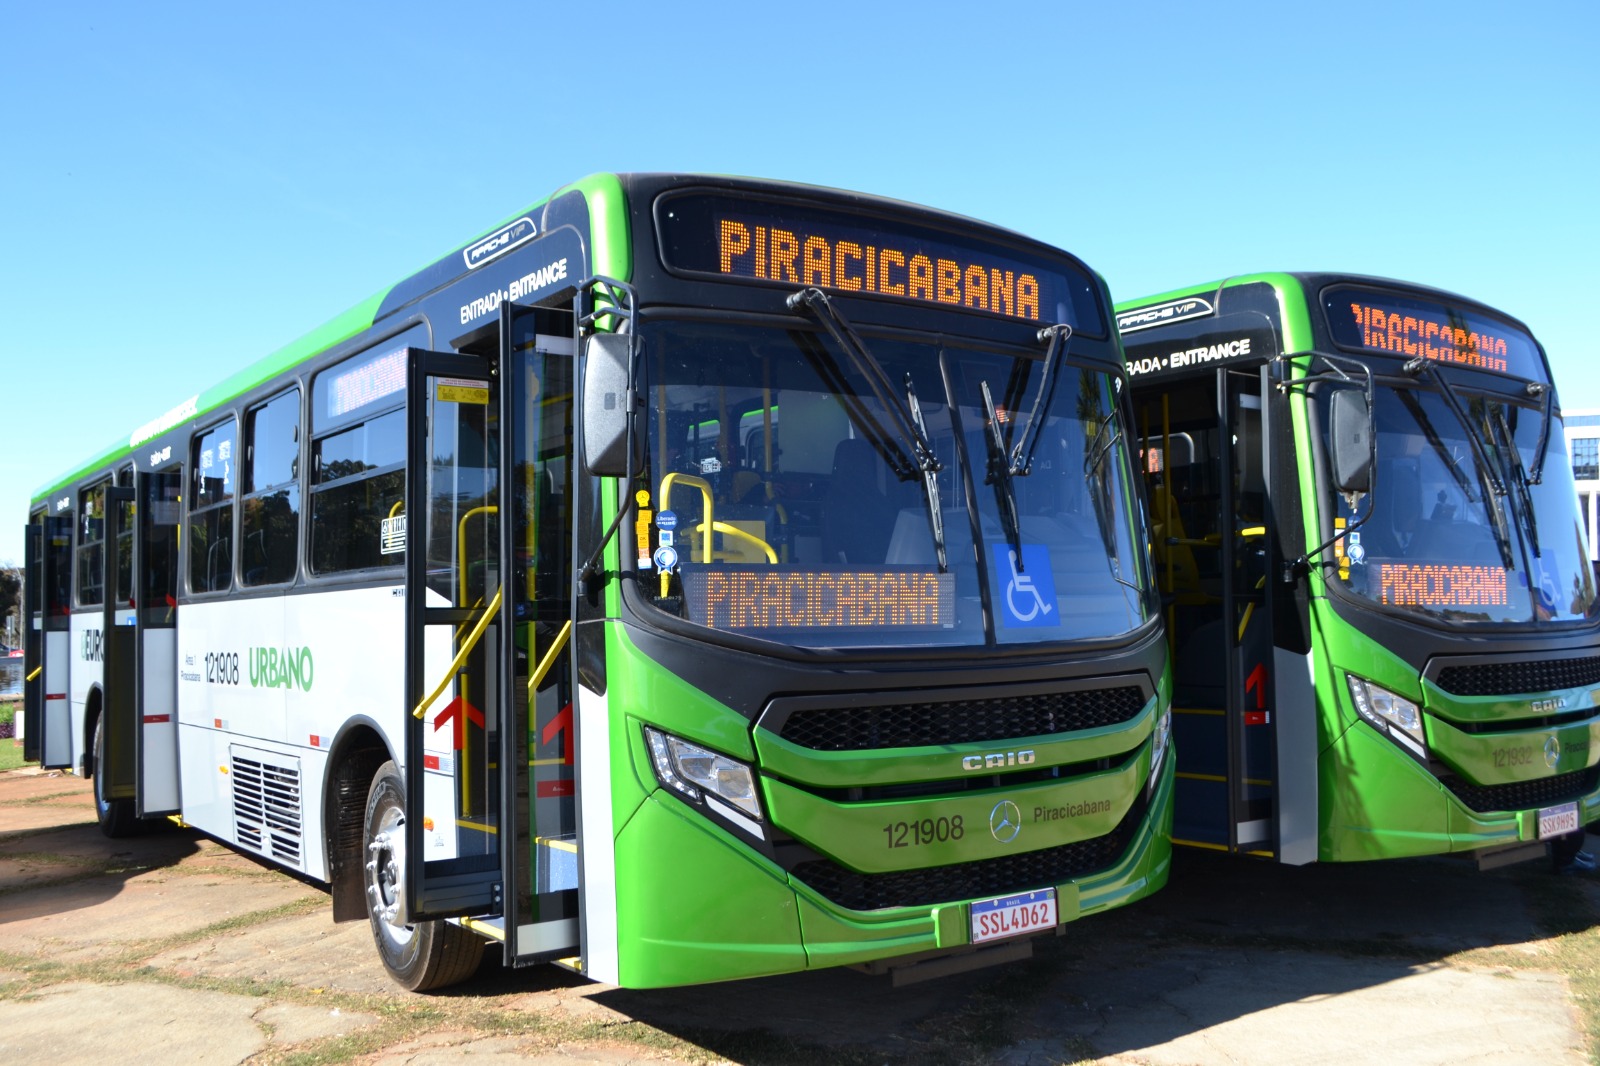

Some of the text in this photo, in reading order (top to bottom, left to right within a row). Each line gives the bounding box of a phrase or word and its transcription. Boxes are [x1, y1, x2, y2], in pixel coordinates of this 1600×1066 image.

[720, 219, 1039, 320] PIRACICABANA
[460, 258, 567, 324] ENTRADA ENTRANCE
[1119, 302, 1197, 327] APACHE VIP
[1127, 338, 1251, 376] RADA ENTRANCE
[707, 572, 938, 628] PIRACICABANA
[1381, 564, 1507, 605] PIRACICABANA
[204, 652, 239, 685] 121908
[249, 646, 313, 692] URBANO
[962, 750, 1035, 770] CAIO
[1034, 800, 1111, 823] Piracicabana
[1542, 812, 1575, 835] SSK9H95
[883, 815, 965, 849] 121908
[980, 903, 1049, 936] SSL4D62
